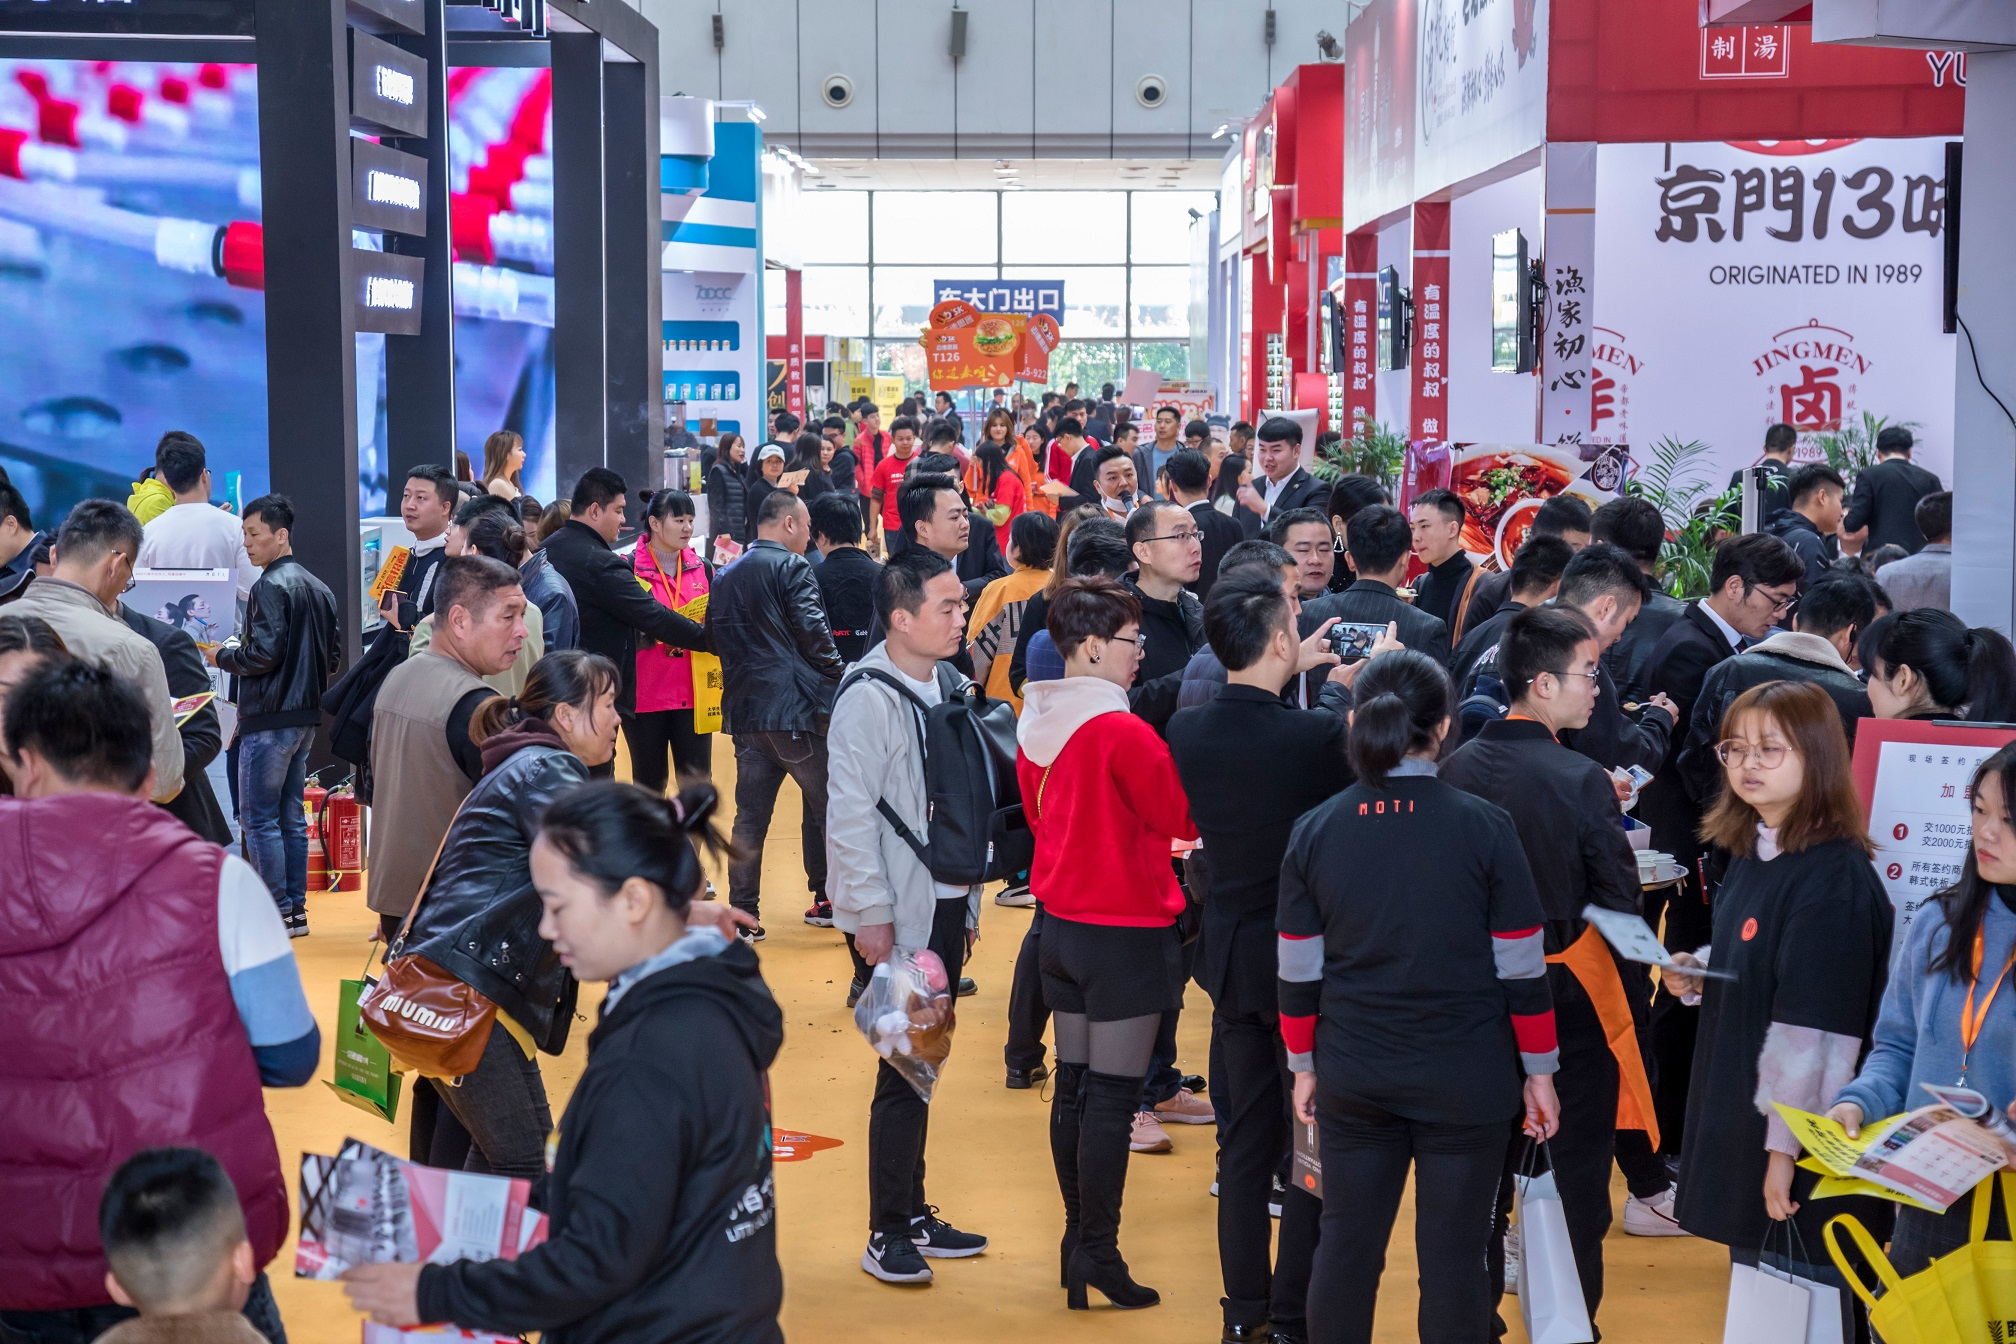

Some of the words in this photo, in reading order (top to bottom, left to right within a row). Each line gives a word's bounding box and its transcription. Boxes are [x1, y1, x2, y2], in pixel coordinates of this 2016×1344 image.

[1709, 264, 1841, 285] ORIGINATED
[1847, 264, 1868, 284] IN
[1876, 263, 1923, 284] 1989
[1352, 299, 1367, 391] 有温度的叔叔
[1422, 284, 1441, 398] 有温度的叔叔
[932, 352, 960, 362] T126
[1752, 341, 1873, 376] JINGMEN
[1780, 364, 1841, 433] 卤
[1797, 447, 1823, 458] 1989
[1358, 799, 1415, 816] MOTI
